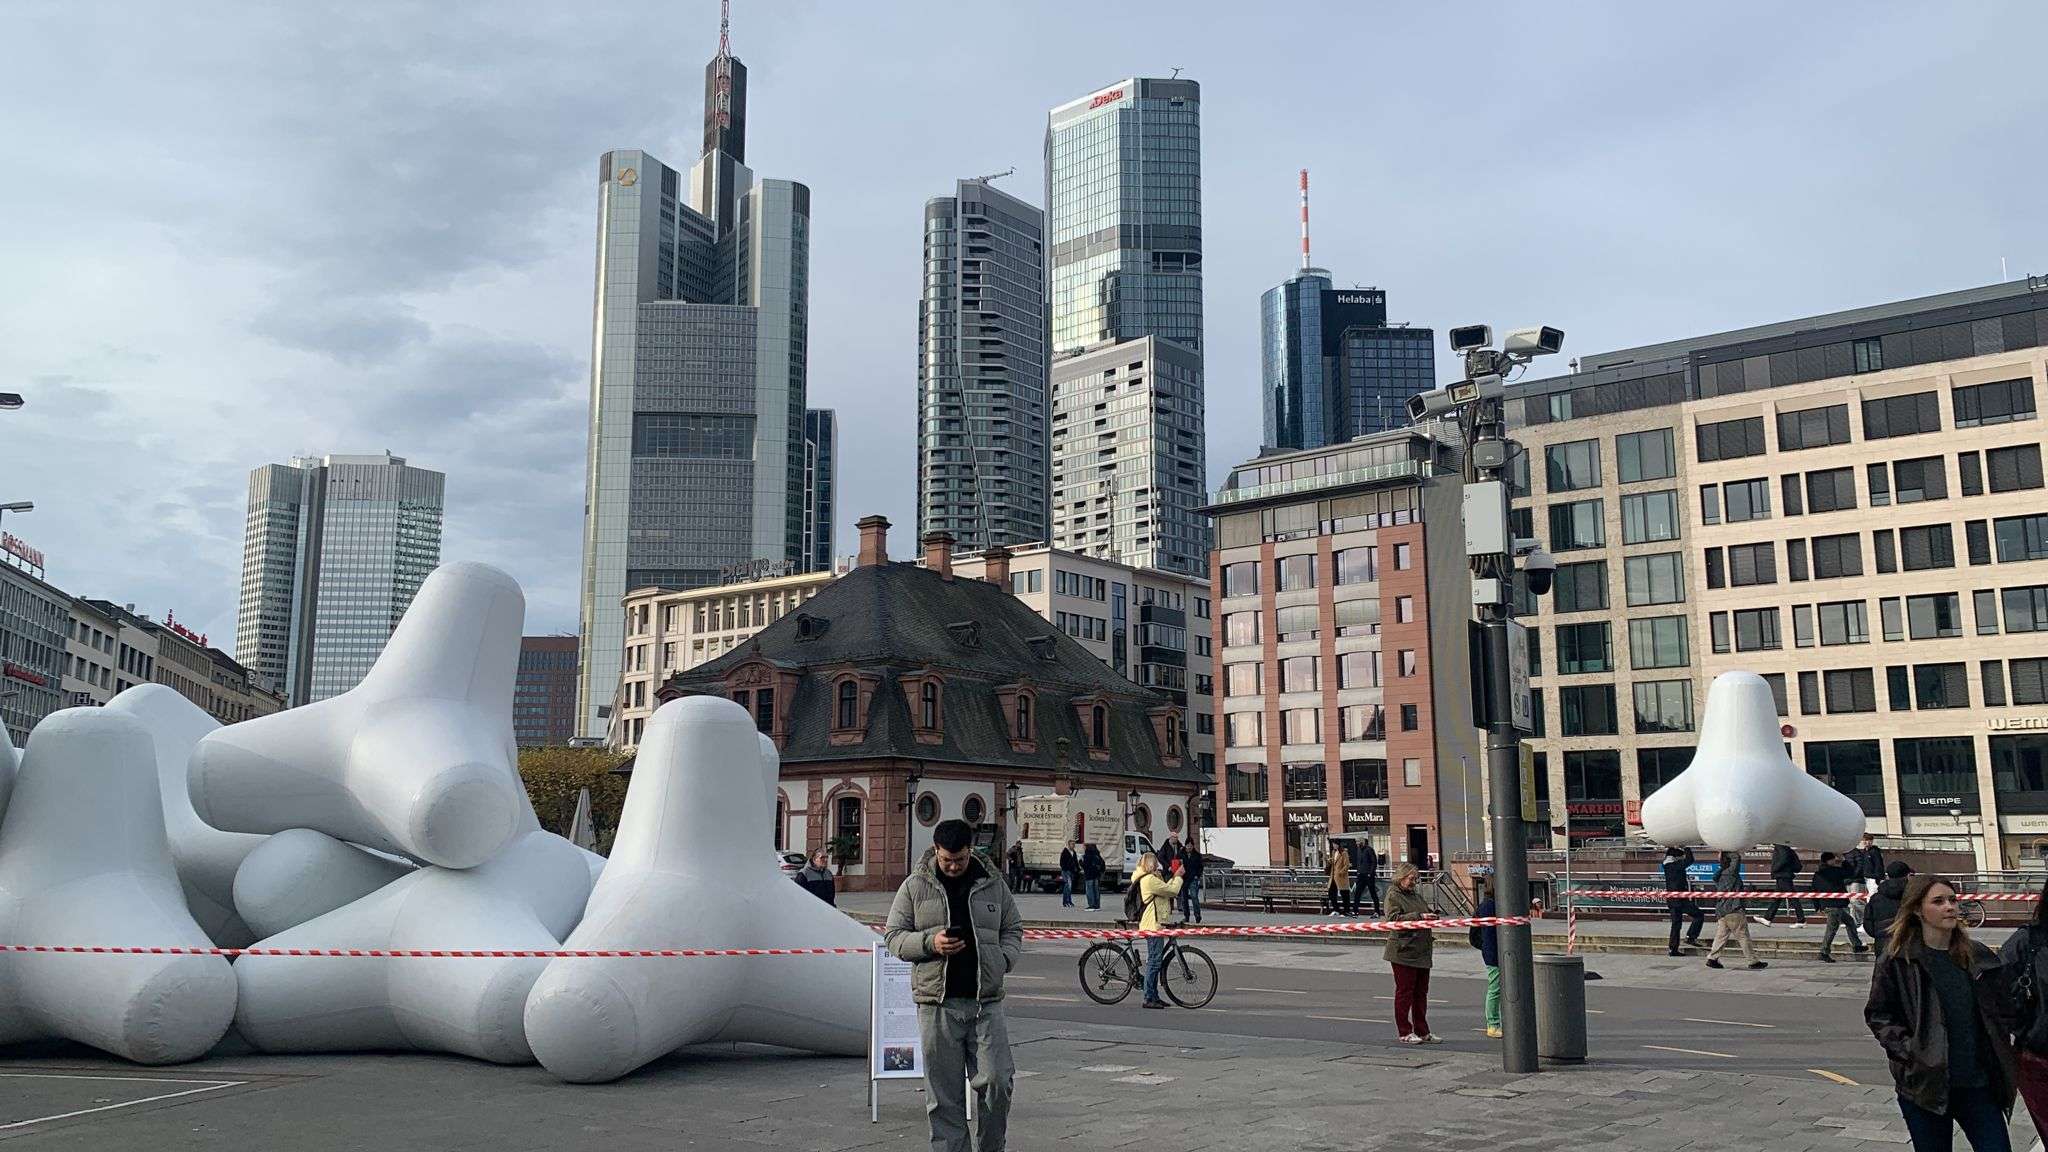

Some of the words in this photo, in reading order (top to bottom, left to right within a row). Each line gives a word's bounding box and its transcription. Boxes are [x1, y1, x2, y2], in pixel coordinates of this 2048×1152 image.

[1094, 90, 1123, 107] Deka
[1337, 294, 1371, 304] Helaba
[1986, 717, 2048, 730] WEM
[1918, 797, 1962, 805] WEMPE
[1033, 804, 1038, 812] S
[1047, 804, 1052, 812] E
[1567, 803, 1622, 814] MAREDO
[1231, 813, 1264, 823] MaxMara
[1288, 812, 1322, 823] MaxMara
[1348, 811, 1384, 822] MaxMara
